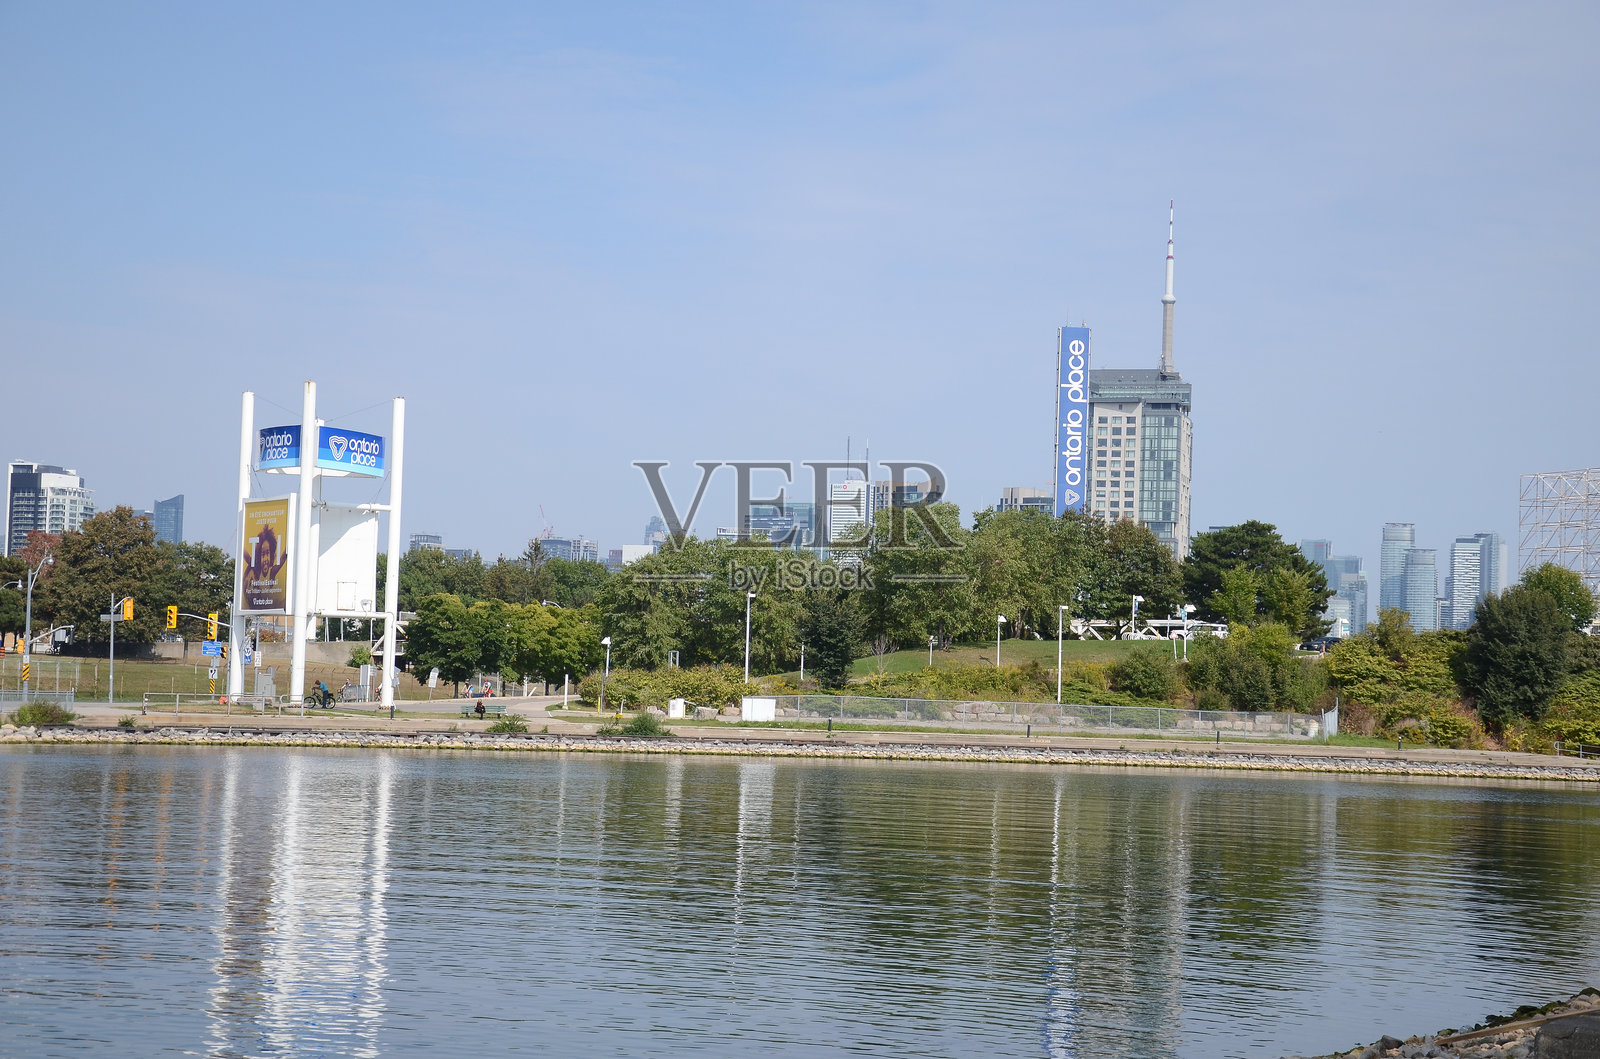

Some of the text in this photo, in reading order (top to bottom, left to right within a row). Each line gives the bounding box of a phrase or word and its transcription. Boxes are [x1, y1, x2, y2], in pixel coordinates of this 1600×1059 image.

[1061, 339, 1087, 486] ontario place
[265, 431, 292, 447] ontario
[348, 437, 380, 455] ontario
[266, 446, 289, 461] place
[350, 448, 376, 467] place
